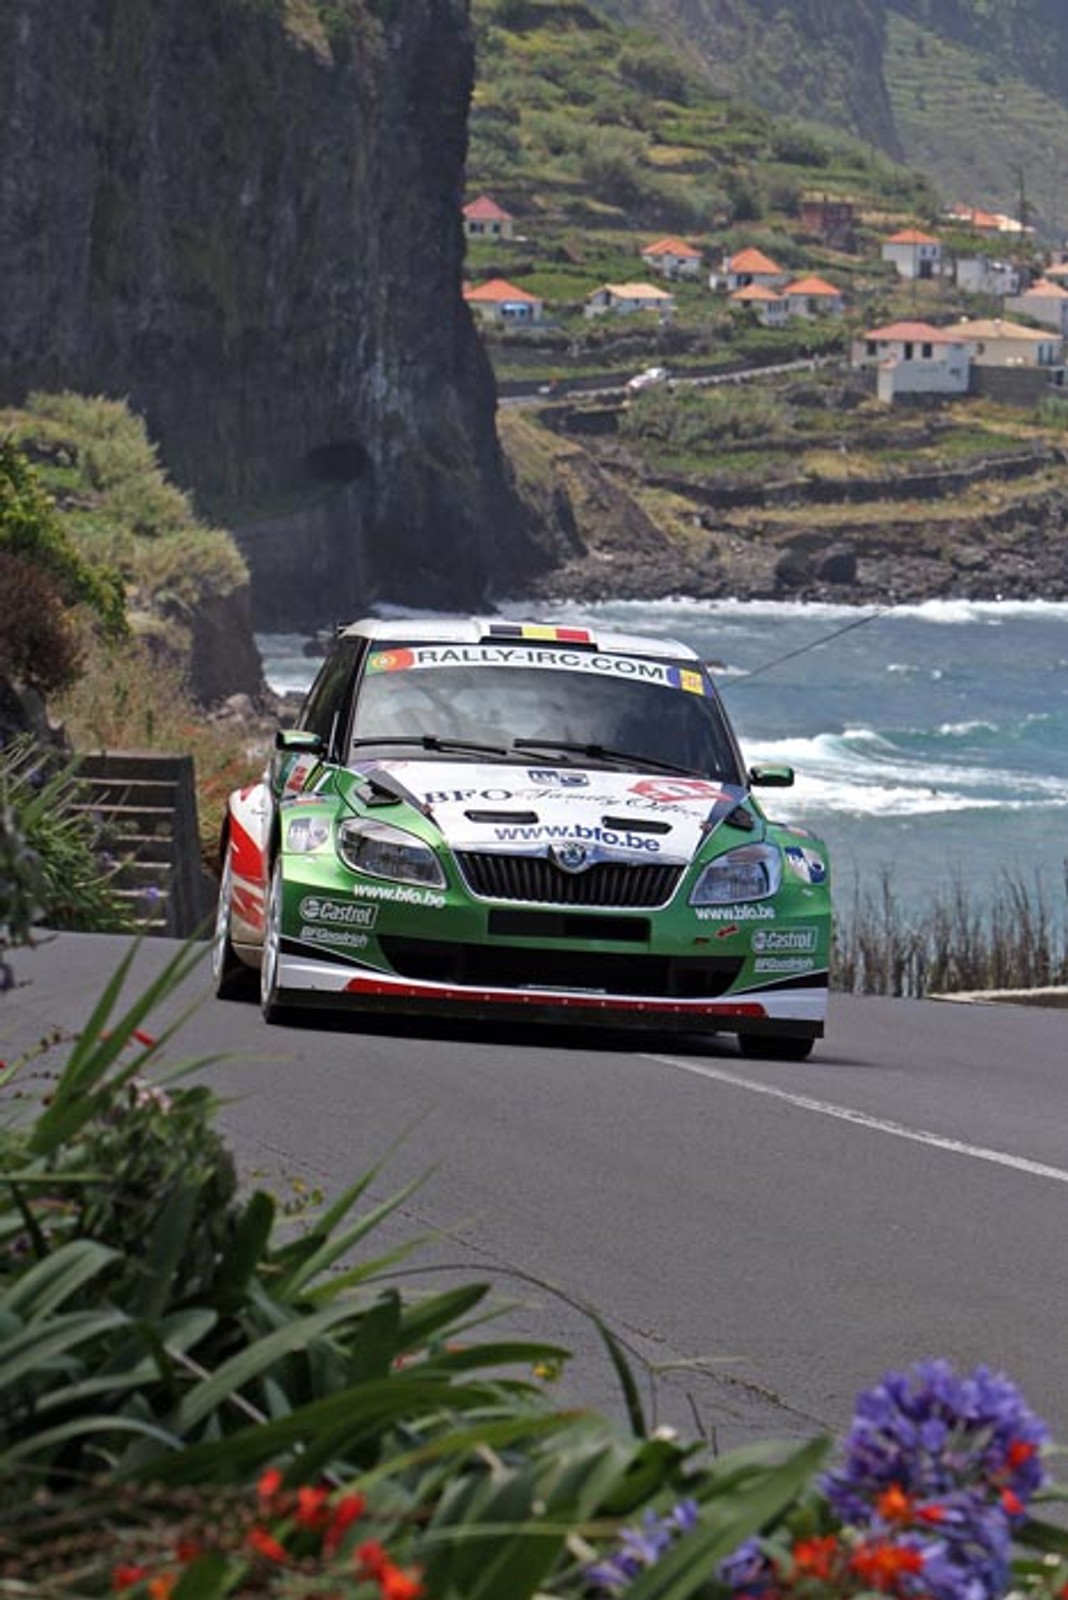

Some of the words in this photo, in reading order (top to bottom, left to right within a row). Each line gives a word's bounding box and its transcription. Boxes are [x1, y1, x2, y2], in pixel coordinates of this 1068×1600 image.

[417, 649, 664, 681] RALLY-IRC.COM
[494, 824, 660, 852] www.bfo.be
[353, 884, 446, 908] www.bfo.be
[320, 902, 371, 925] Castrol
[695, 904, 776, 920] www.bfo.be
[766, 932, 813, 949] Castrol
